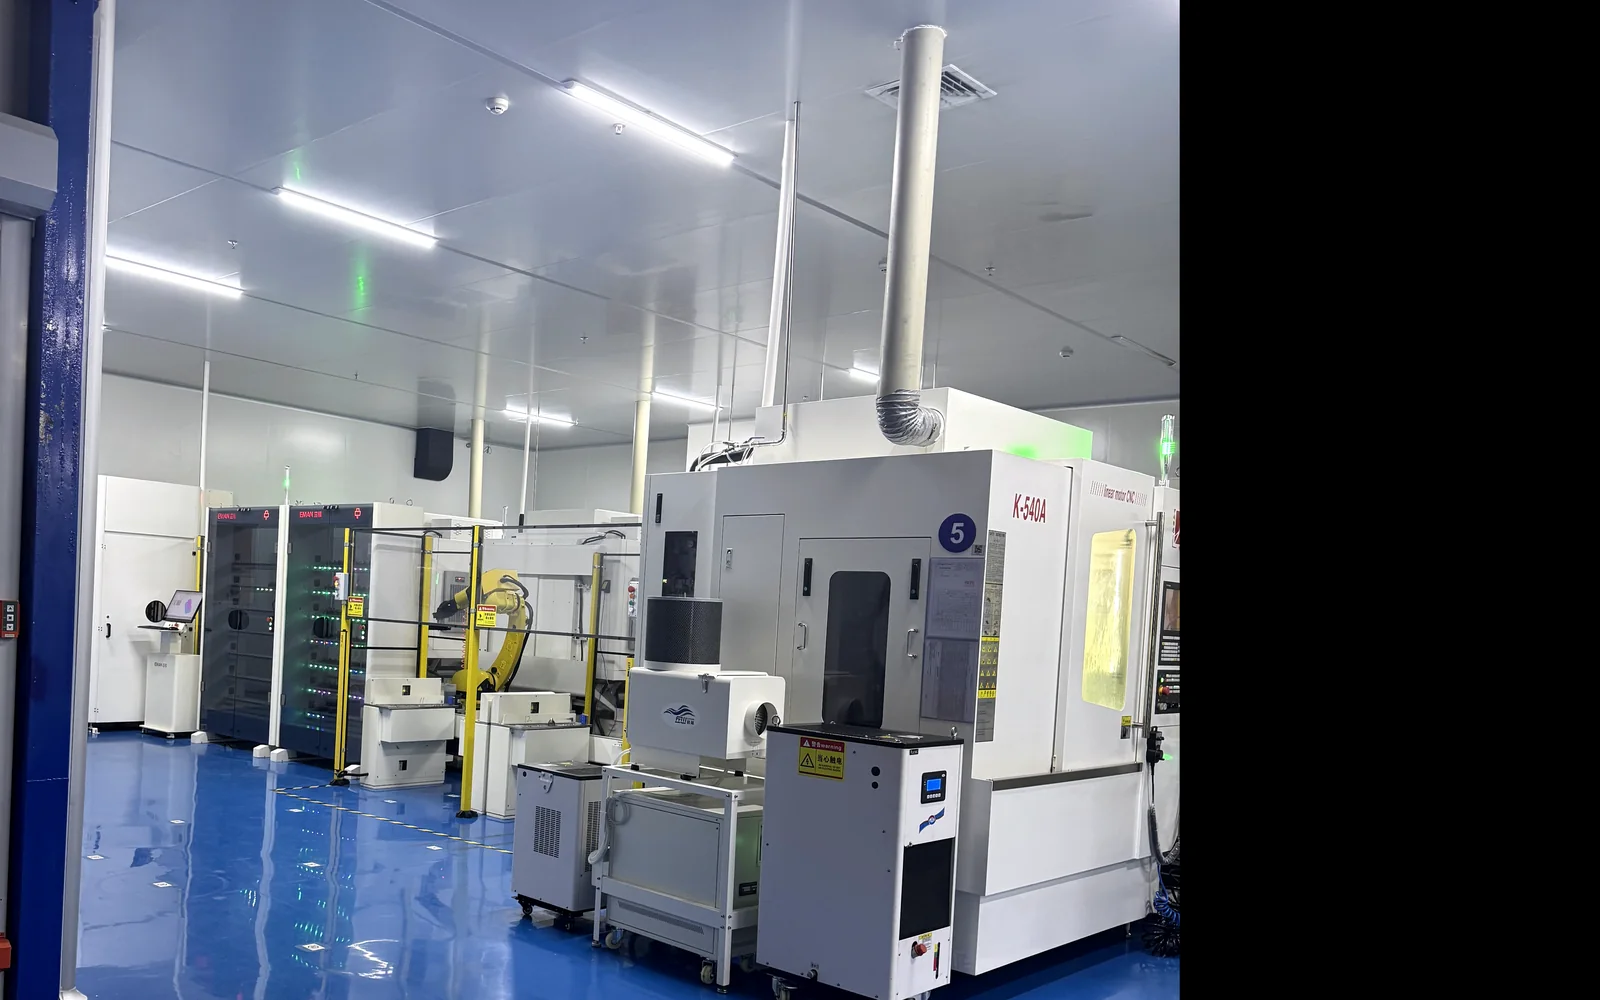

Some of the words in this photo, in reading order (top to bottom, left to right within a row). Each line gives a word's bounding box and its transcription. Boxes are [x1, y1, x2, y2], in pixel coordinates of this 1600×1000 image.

[1012, 493, 1046, 523] K-540A
[1126, 490, 1135, 504] CNC
[949, 522, 965, 544] 5
